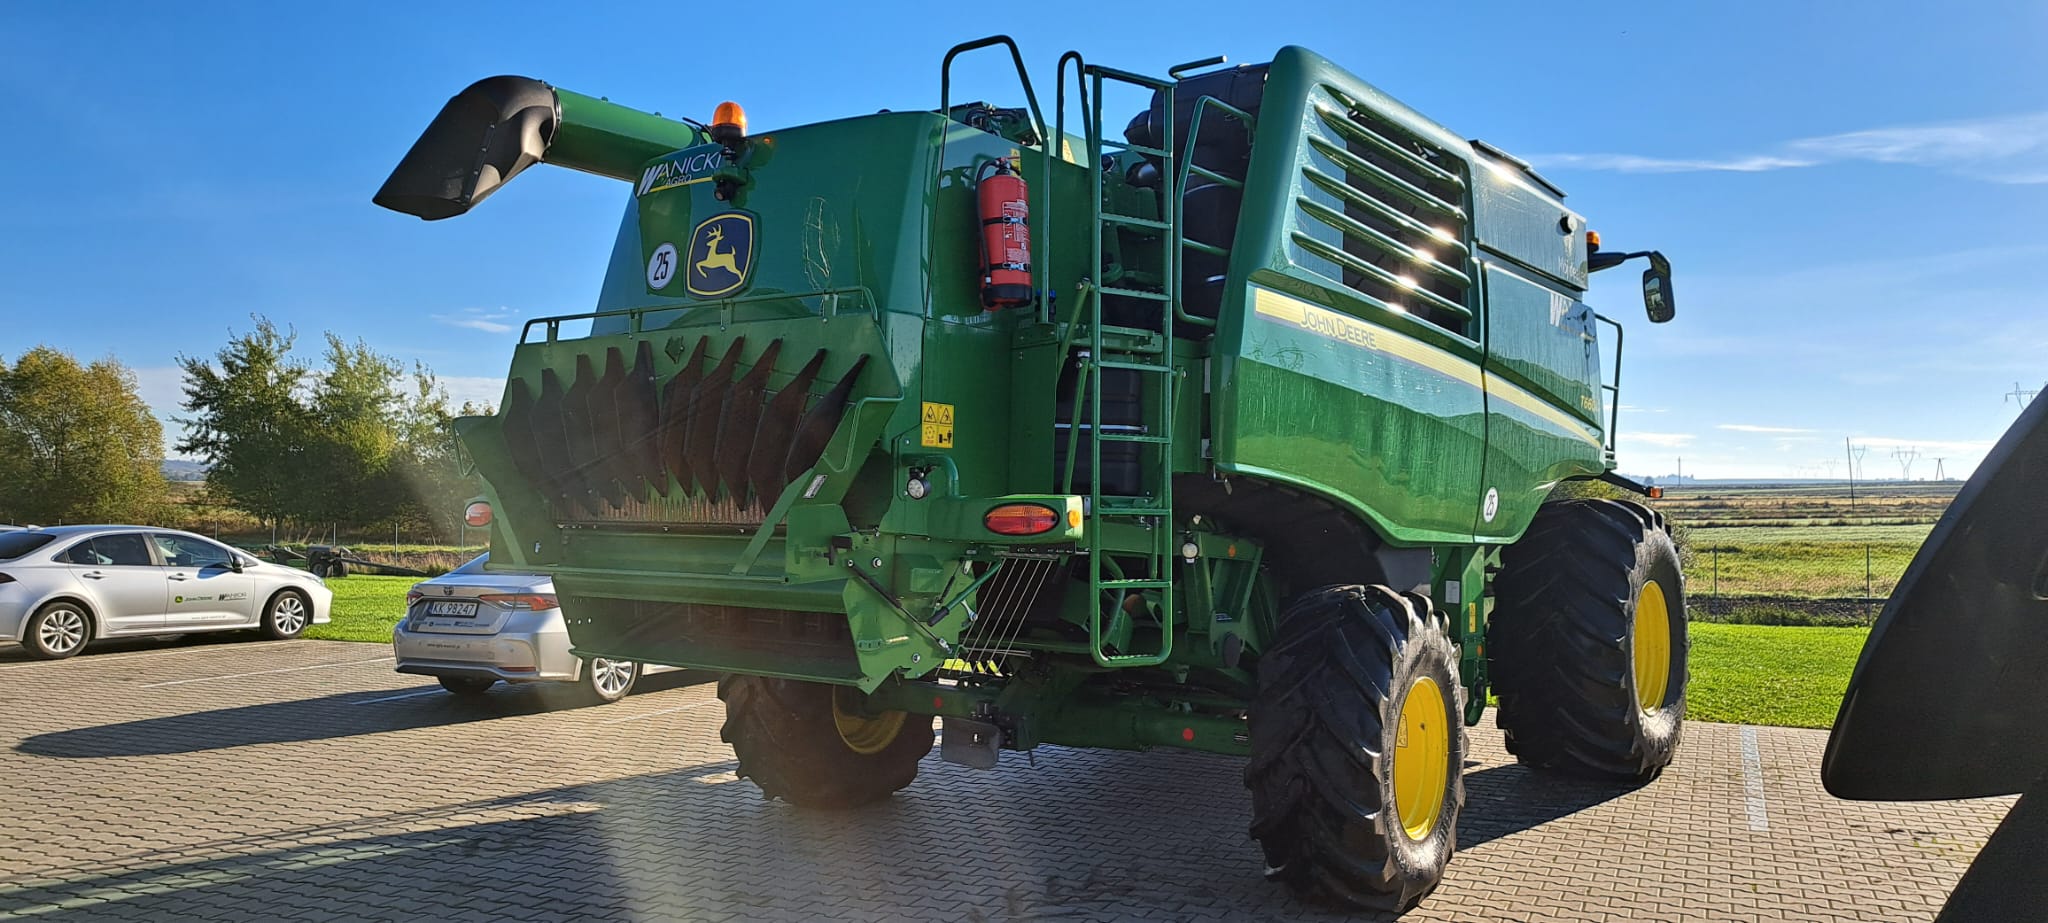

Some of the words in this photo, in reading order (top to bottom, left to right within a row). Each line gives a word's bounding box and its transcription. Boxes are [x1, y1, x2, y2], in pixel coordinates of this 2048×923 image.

[637, 151, 722, 197] WANICKI
[665, 174, 692, 187] AGRO
[653, 250, 671, 281] 25
[1301, 306, 1336, 335] JOHN
[1336, 317, 1377, 348] DEERE
[1486, 494, 1496, 516] 25
[432, 602, 446, 614] KK
[446, 603, 475, 615] 98247
